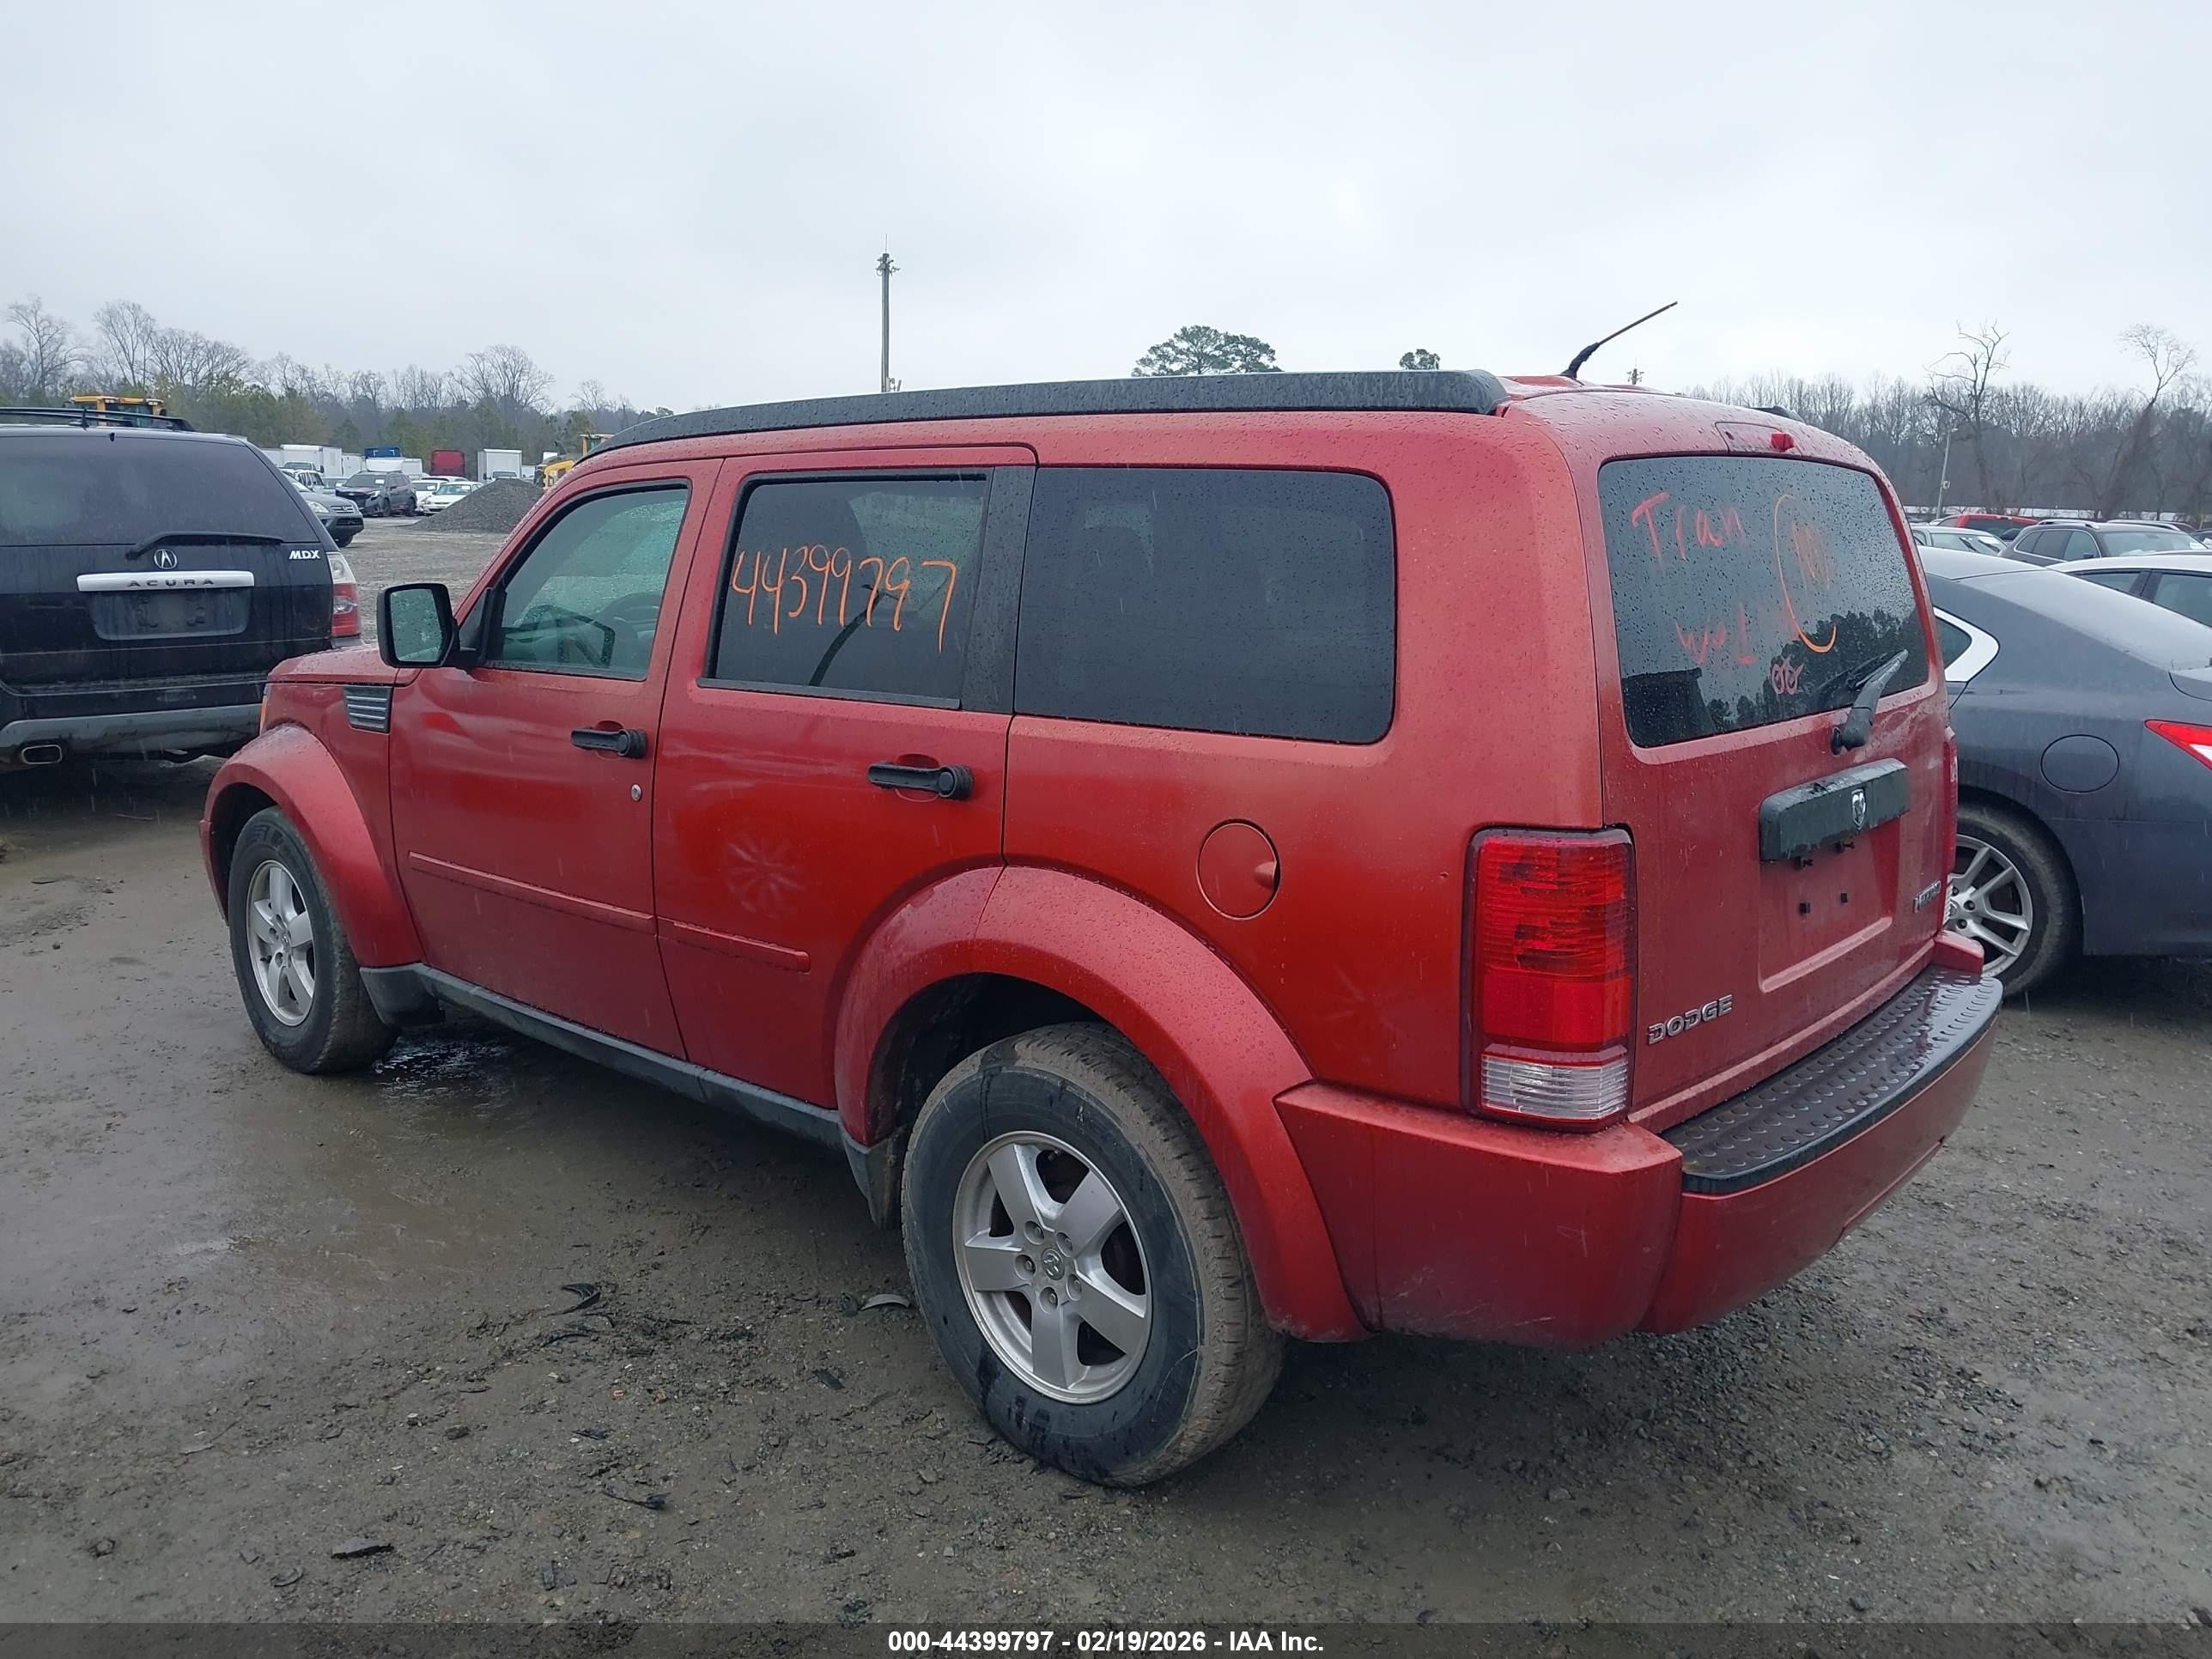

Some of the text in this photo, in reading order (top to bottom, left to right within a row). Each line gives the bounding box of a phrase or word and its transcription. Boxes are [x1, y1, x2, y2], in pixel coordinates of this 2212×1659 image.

[289, 550, 320, 560] MDX
[129, 578, 215, 587] ACURA
[732, 544, 957, 653] 44399797
[1648, 994, 1733, 1045] DODGE
